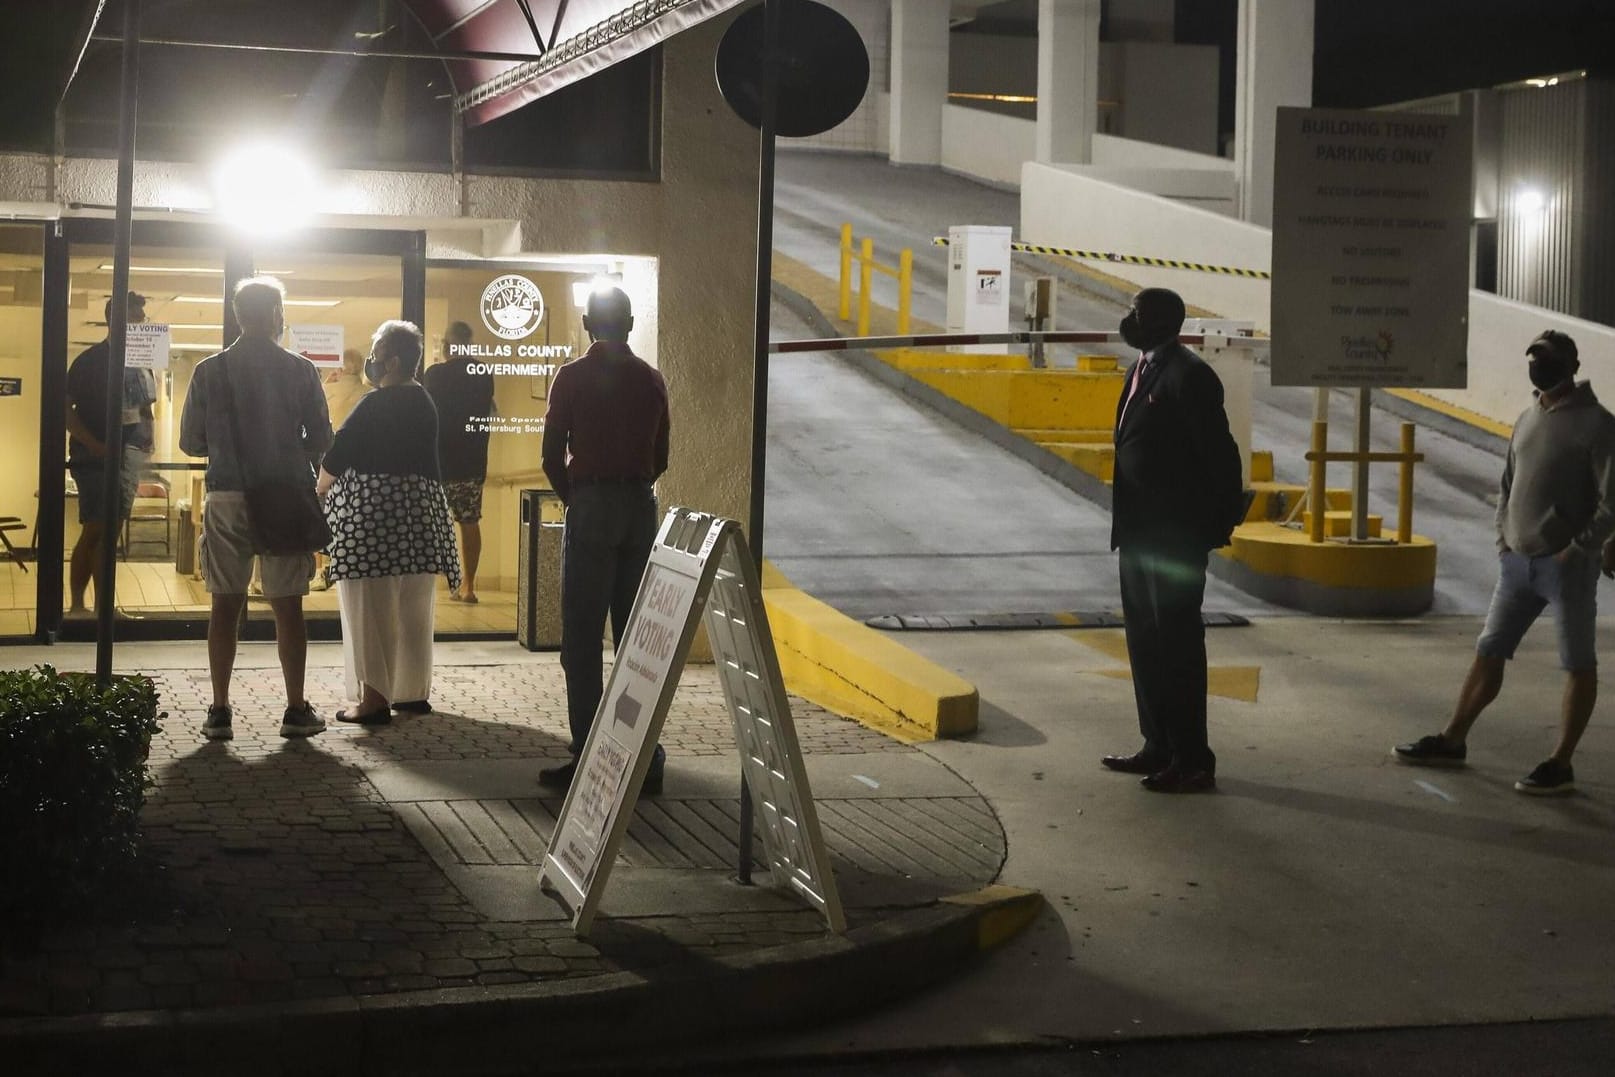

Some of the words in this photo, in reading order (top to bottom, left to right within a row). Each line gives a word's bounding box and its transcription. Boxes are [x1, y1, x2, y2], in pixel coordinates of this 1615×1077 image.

[1301, 118, 1380, 137] BUILDING
[1384, 121, 1449, 140] TENANT
[1315, 144, 1387, 163] PARKING
[1392, 148, 1434, 165] ONLY
[485, 278, 514, 302] PINELLAS
[516, 279, 540, 302] COUNTY
[139, 324, 168, 333] VOTING
[449, 344, 512, 357] PINELLAS
[517, 345, 573, 358] COUNTY
[466, 363, 556, 376] GOVERNMENT
[465, 424, 477, 433] St.
[479, 424, 522, 434] Petersburg
[648, 578, 686, 619] EARLY
[633, 615, 675, 661] VOTING
